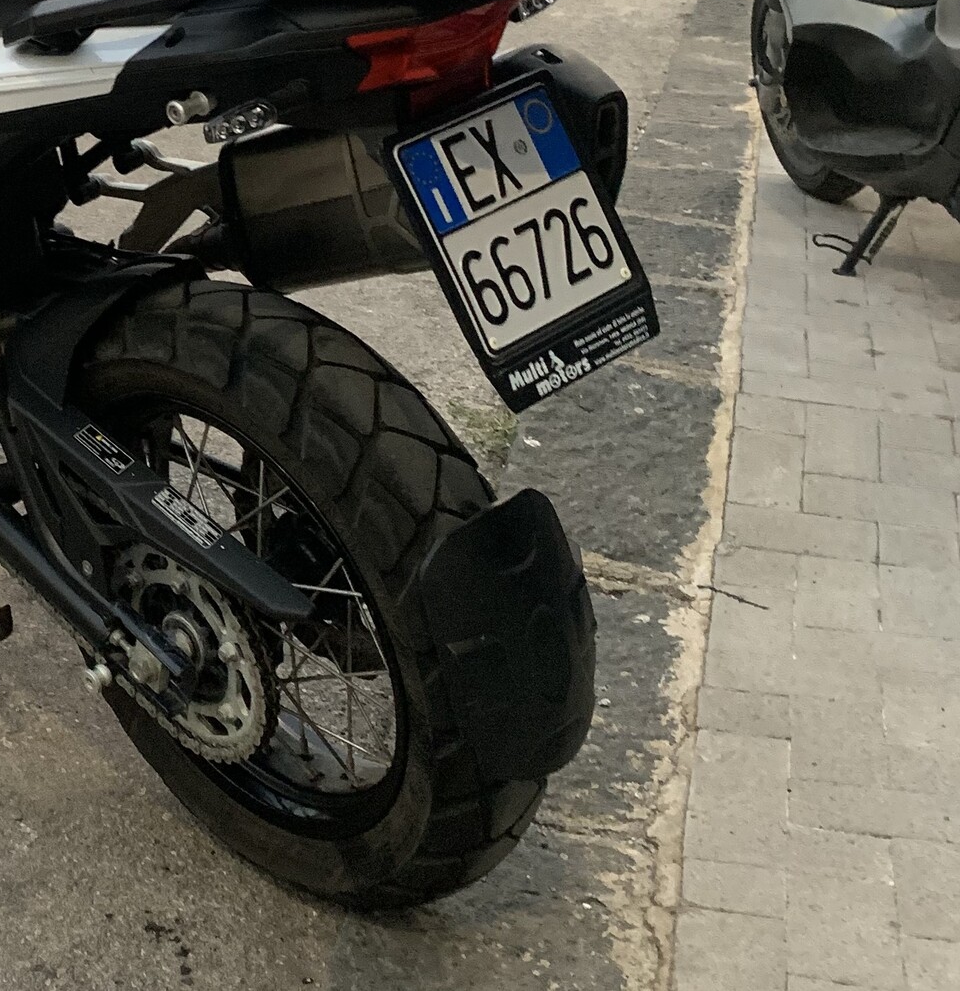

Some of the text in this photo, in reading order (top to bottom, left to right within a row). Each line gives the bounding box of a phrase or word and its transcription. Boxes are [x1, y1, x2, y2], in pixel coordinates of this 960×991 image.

[439, 119, 523, 213] EX
[461, 197, 614, 326] 66726
[508, 356, 549, 391] Multi
[535, 357, 592, 397] motors
